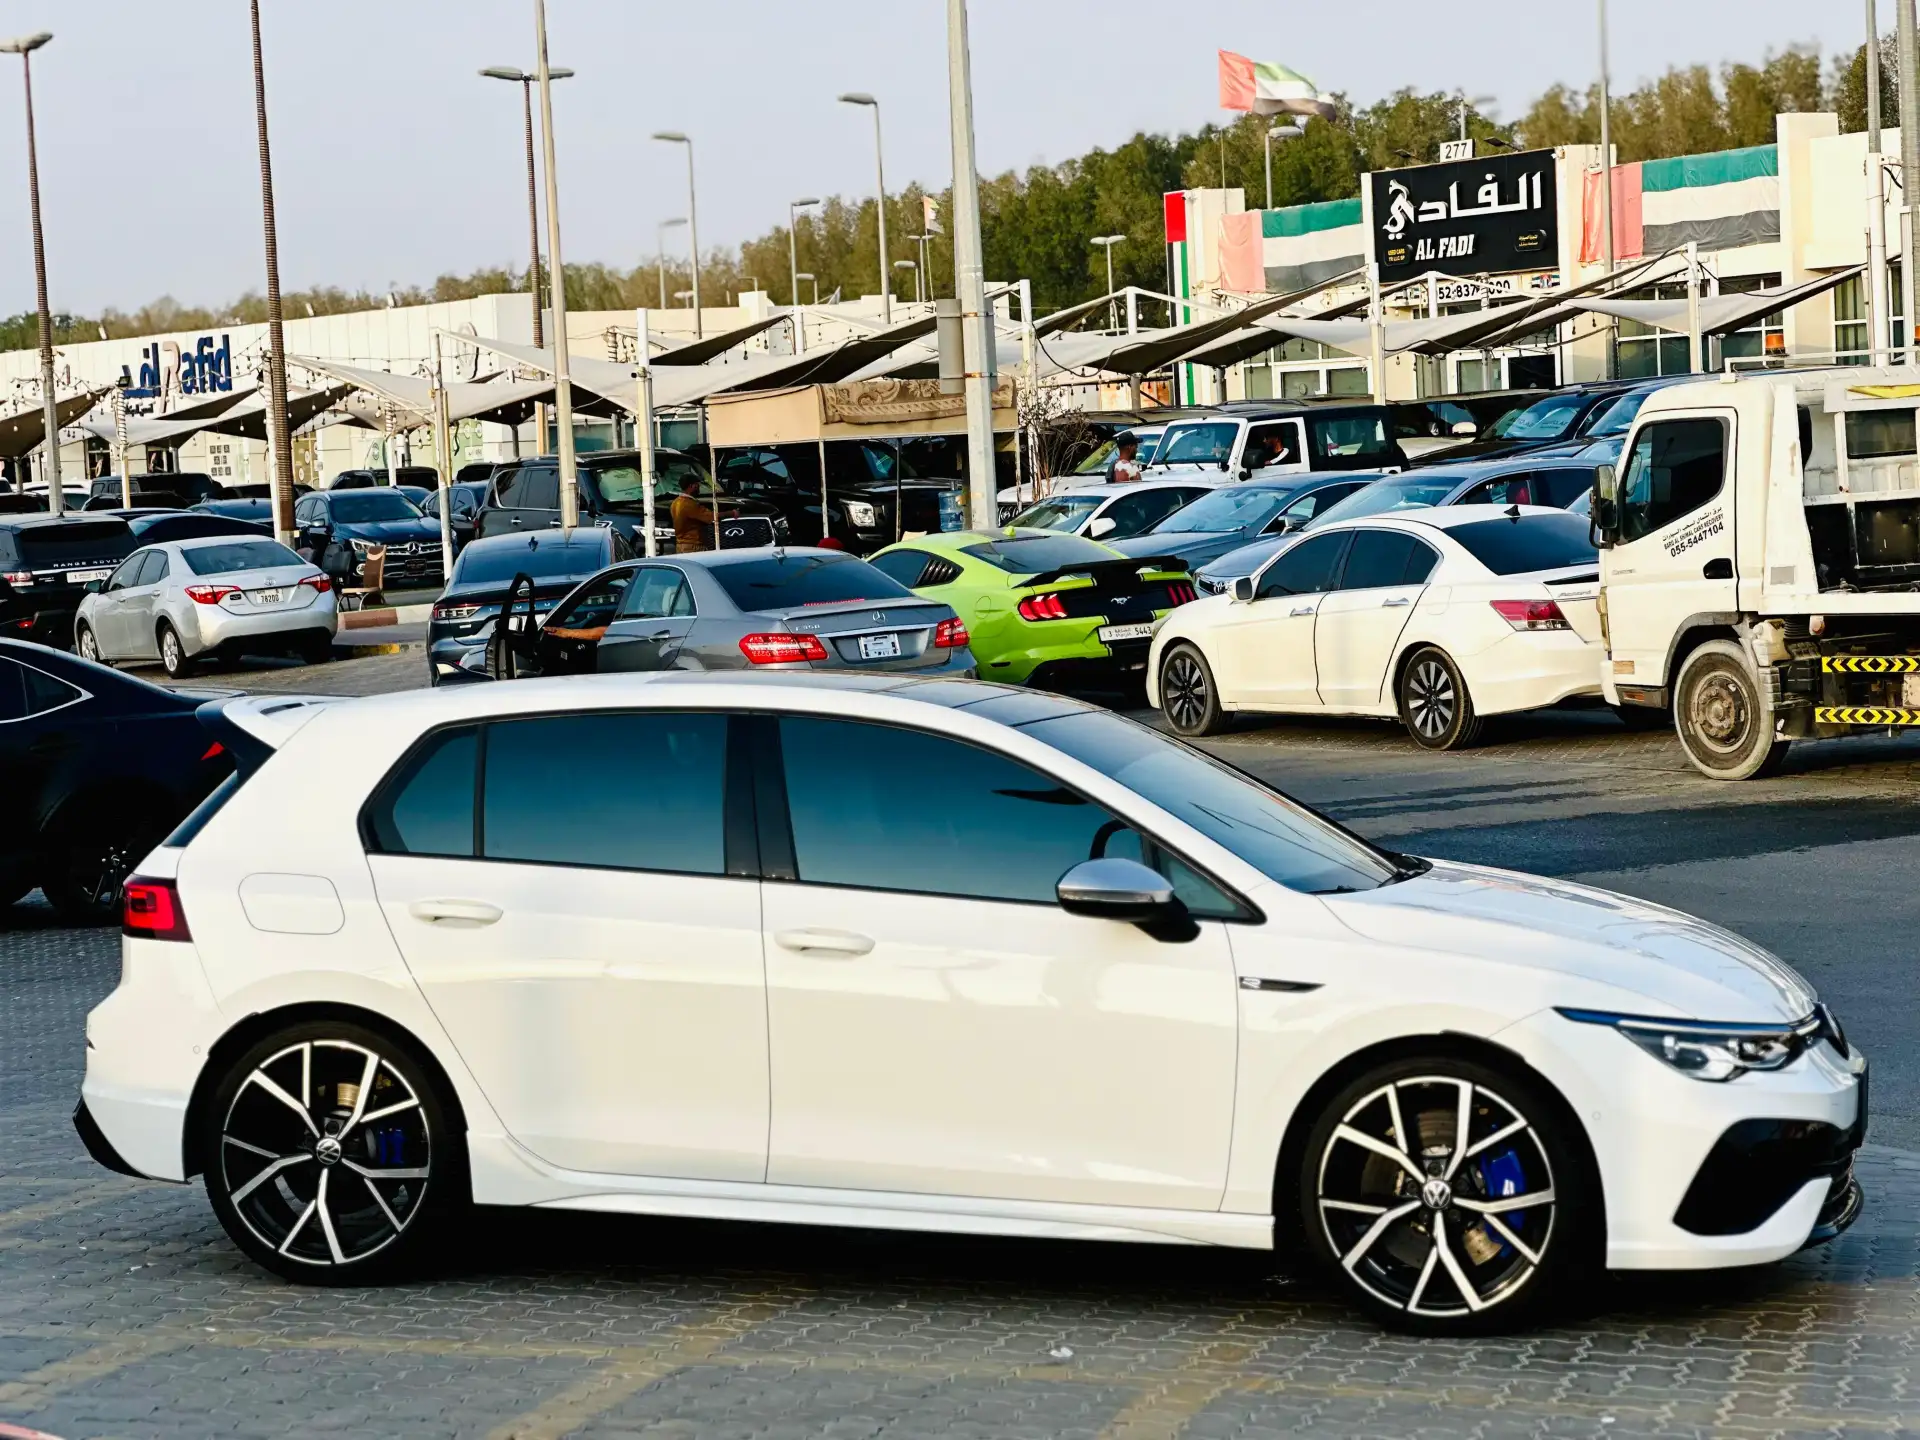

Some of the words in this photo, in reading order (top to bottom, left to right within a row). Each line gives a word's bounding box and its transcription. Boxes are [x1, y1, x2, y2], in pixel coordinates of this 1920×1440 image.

[1445, 142, 1468, 159] 277
[1383, 171, 1544, 240] الفادي
[1415, 238, 1436, 261] AL
[1438, 233, 1476, 258] FADI
[160, 334, 233, 413] Rafid
[1670, 521, 1724, 557] 055-5447104
